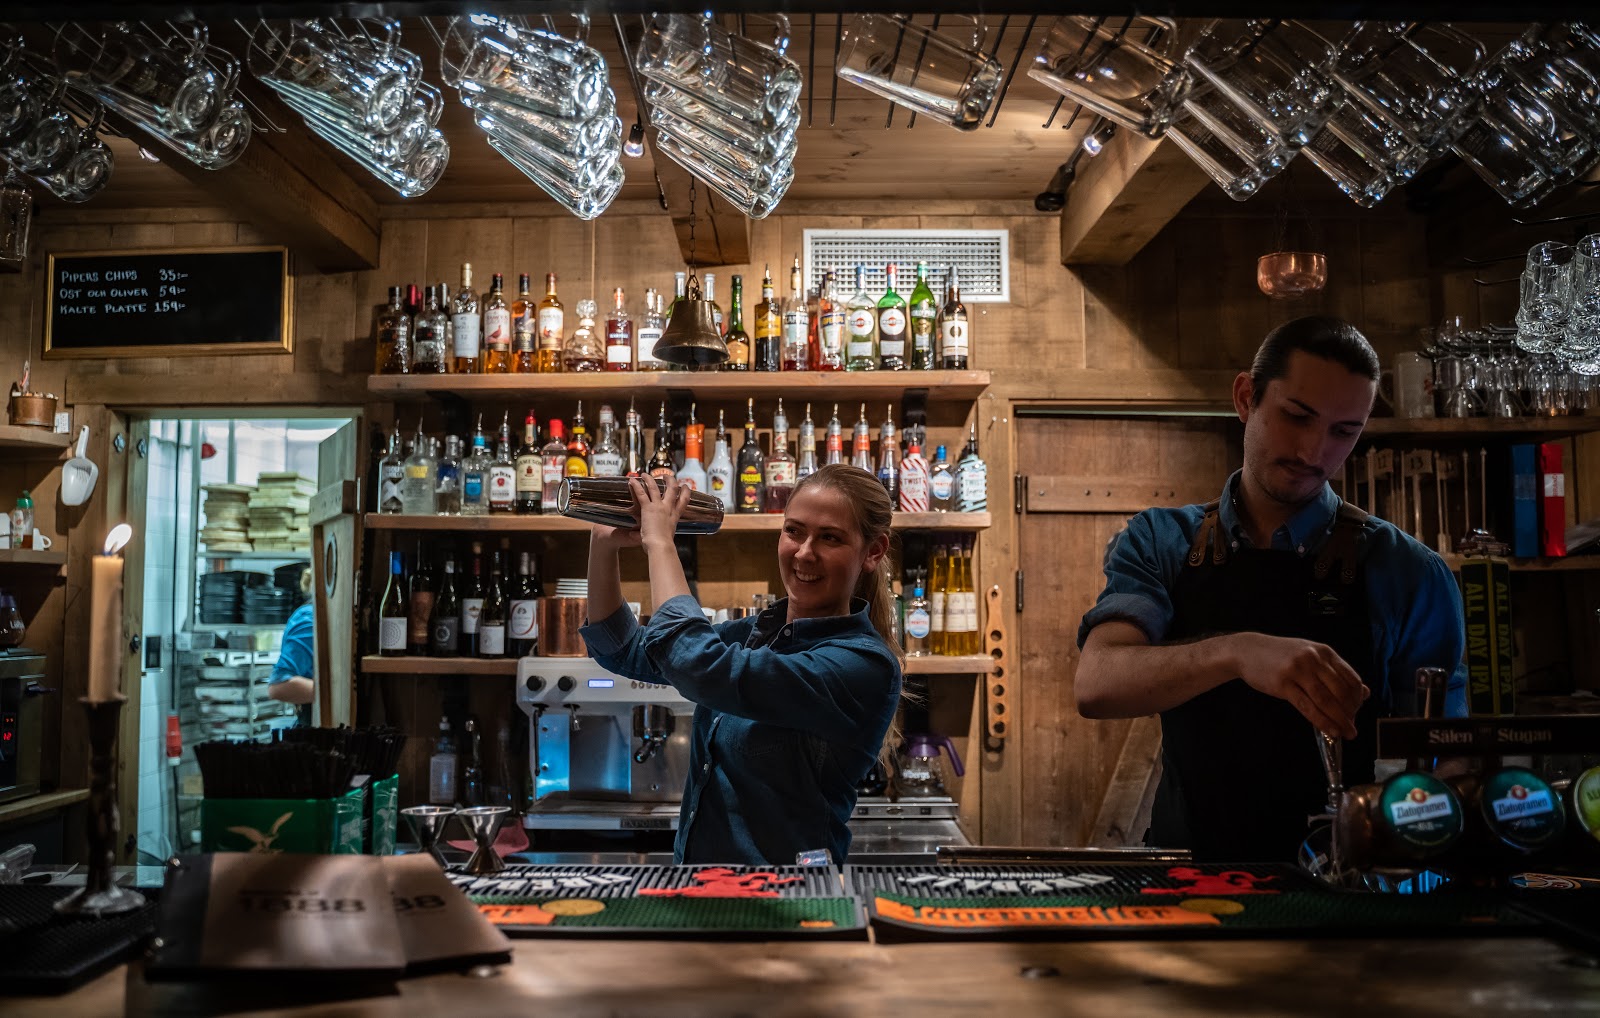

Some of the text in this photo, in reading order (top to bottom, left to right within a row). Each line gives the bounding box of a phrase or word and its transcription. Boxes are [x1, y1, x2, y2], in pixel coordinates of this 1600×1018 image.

[61, 270, 99, 283] PIPERS
[105, 270, 138, 281] CHIPS
[59, 288, 81, 300] OST
[110, 288, 148, 297] OLIVER
[60, 304, 96, 315] KALTE
[104, 303, 147, 314] PLATTE
[1465, 582, 1490, 695] ALL DAY IPA
[1495, 581, 1512, 695] ALL DAY IPA
[1396, 800, 1447, 819] Zlatopramen
[1497, 797, 1548, 816] Zlatopramen
